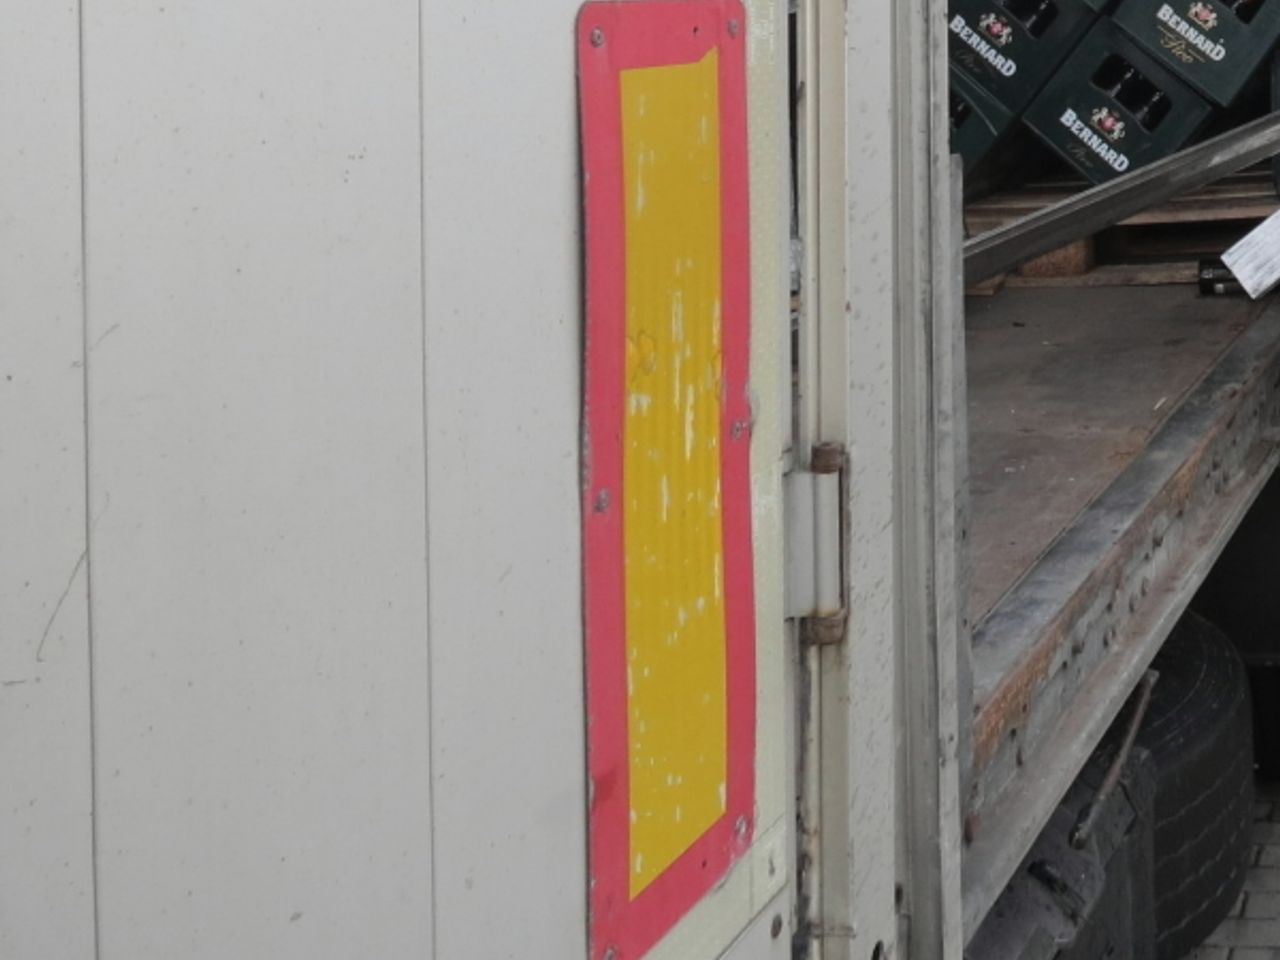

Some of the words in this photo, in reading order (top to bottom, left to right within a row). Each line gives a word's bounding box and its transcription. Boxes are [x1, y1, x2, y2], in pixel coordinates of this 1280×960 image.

[949, 14, 1017, 77] BERNARD
[1156, 3, 1227, 62] BERNARD
[1059, 108, 1130, 172] BERNARD
